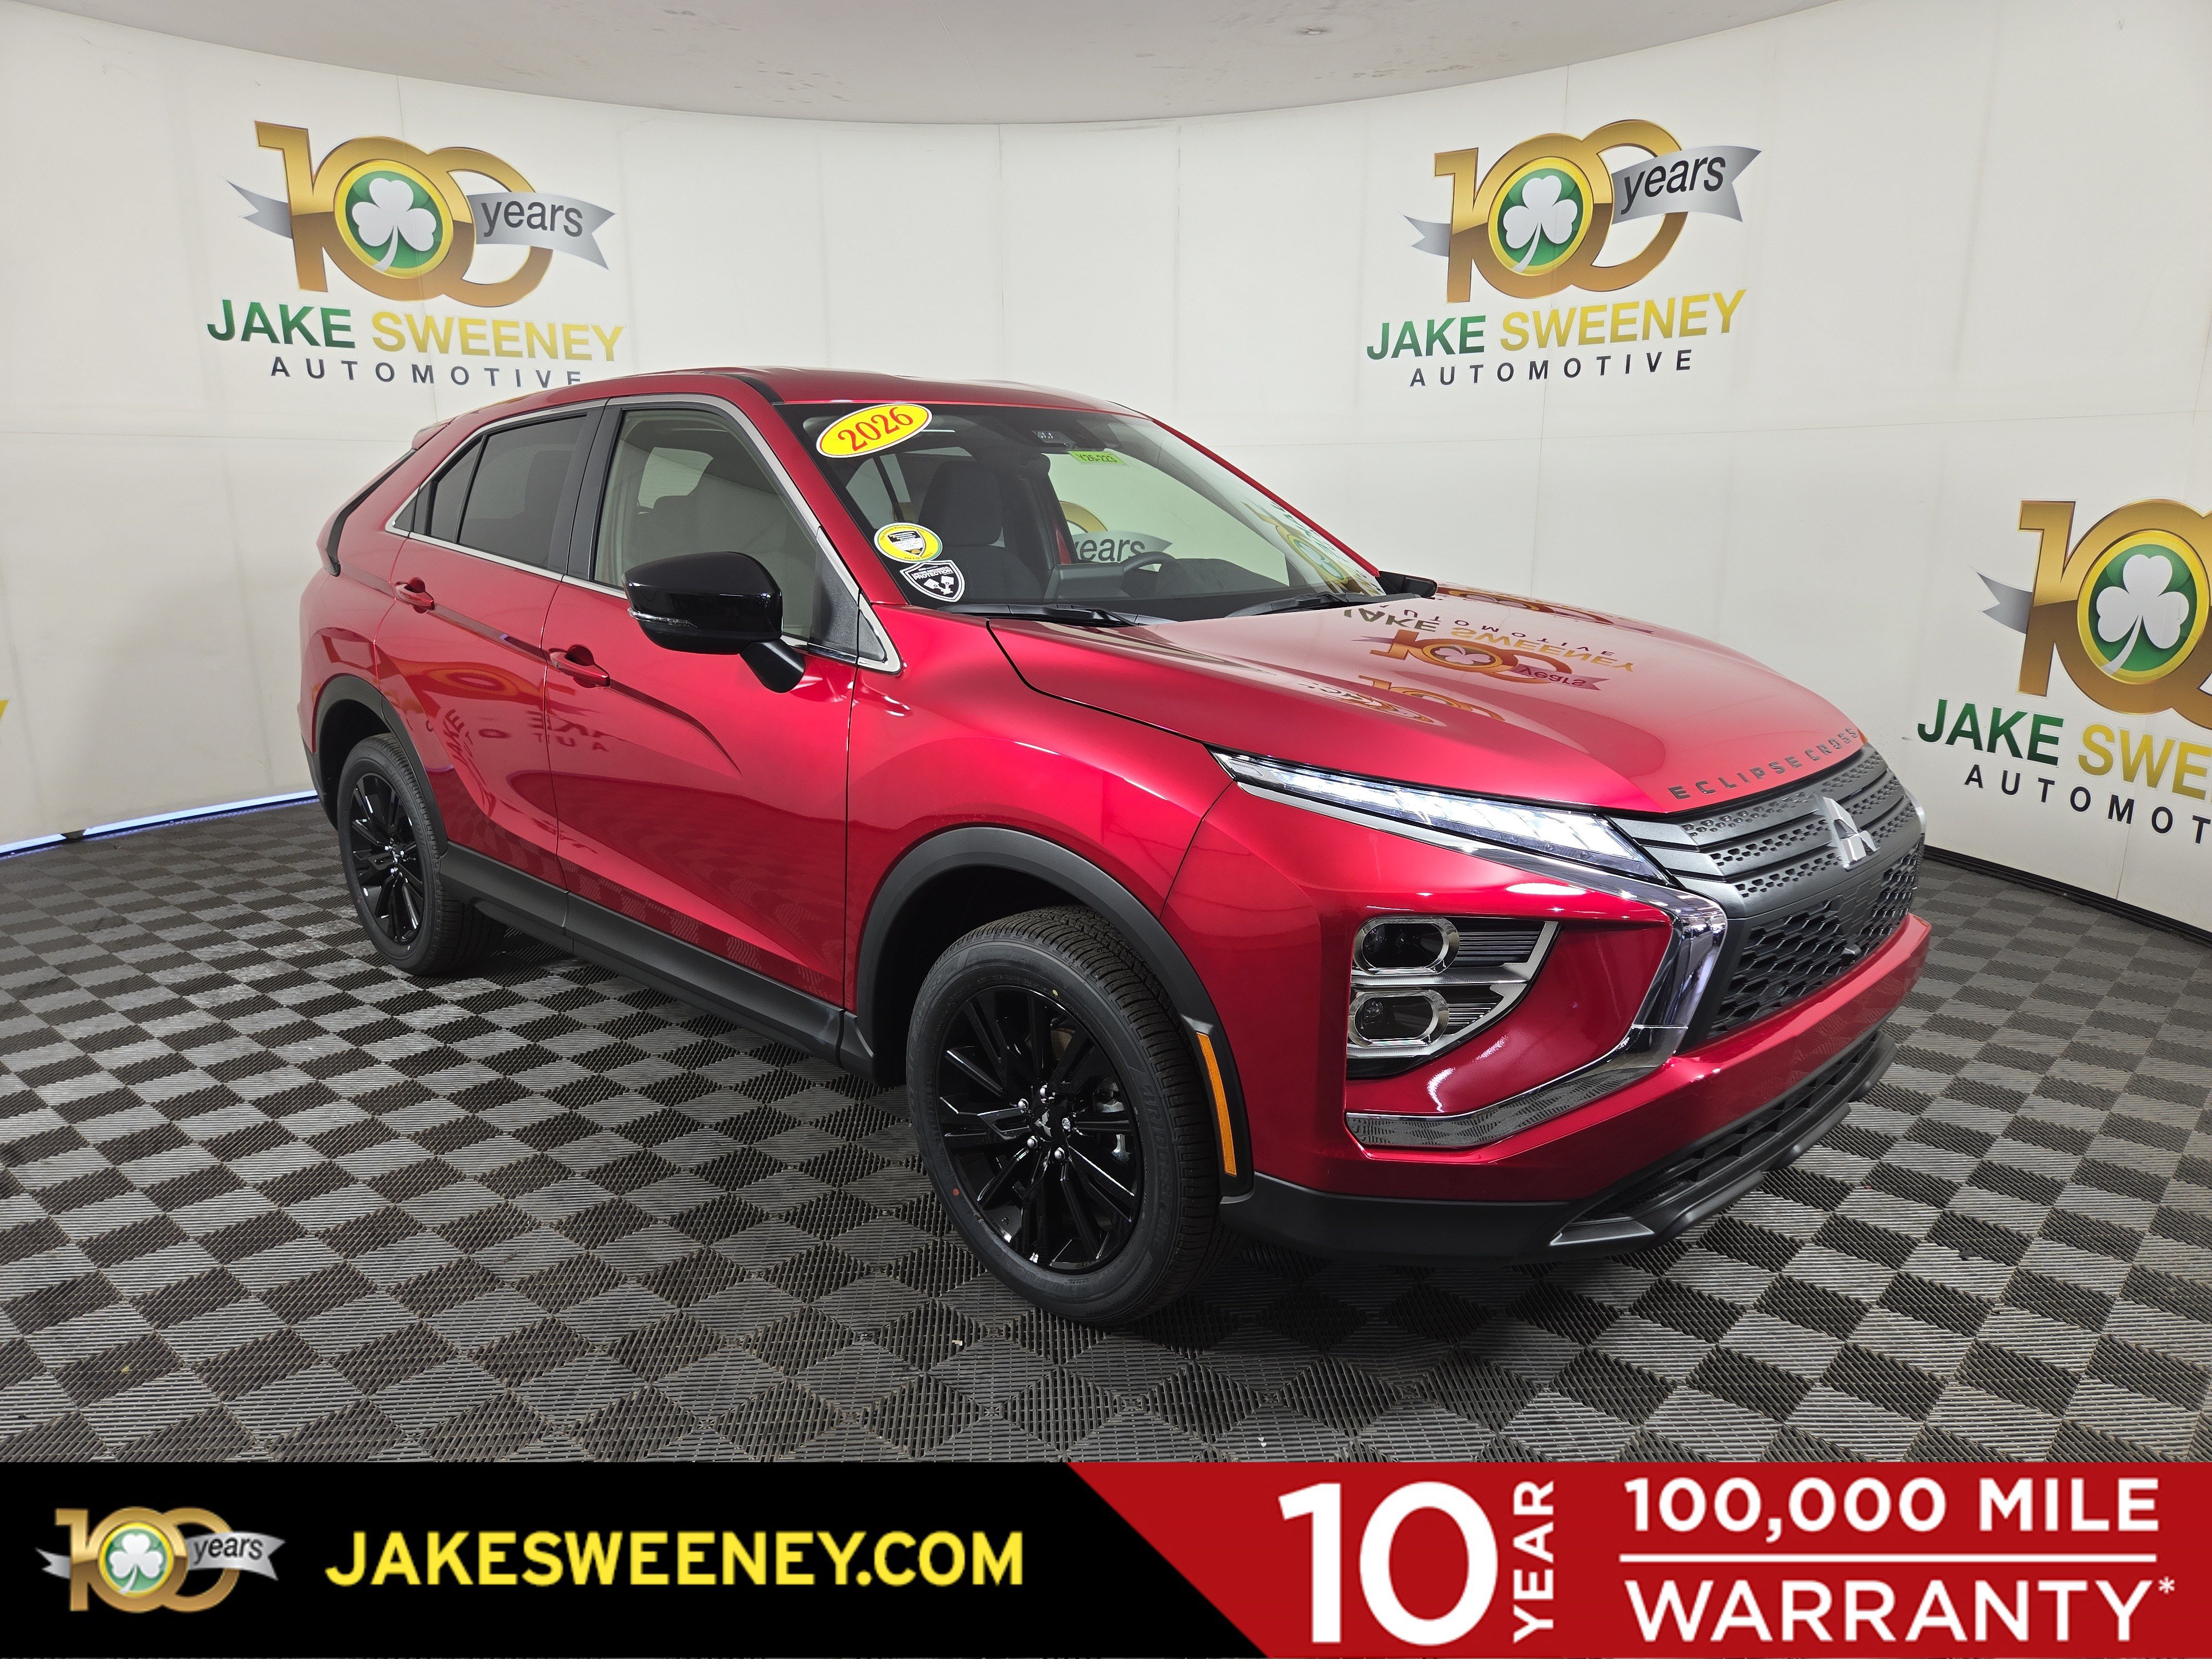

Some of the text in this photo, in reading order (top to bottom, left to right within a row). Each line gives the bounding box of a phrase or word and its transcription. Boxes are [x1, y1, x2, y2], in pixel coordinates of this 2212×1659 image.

[1620, 155, 1727, 215] years
[481, 200, 583, 237] years
[207, 299, 624, 362] JAKE SWEENEY
[1367, 288, 1747, 360] JAKE SWEENEY
[271, 356, 581, 389] AUTOMOTIVE
[1410, 349, 1692, 388] AUTOMOTIVE
[838, 407, 914, 452] 2026
[1075, 453, 1117, 462] Y26-223
[914, 568, 953, 580] PROTECTION
[1668, 727, 1859, 800] ECLIPSE CROSS
[1917, 699, 2212, 802] JAKE SWE
[1965, 764, 2211, 844] AUTOMOT
